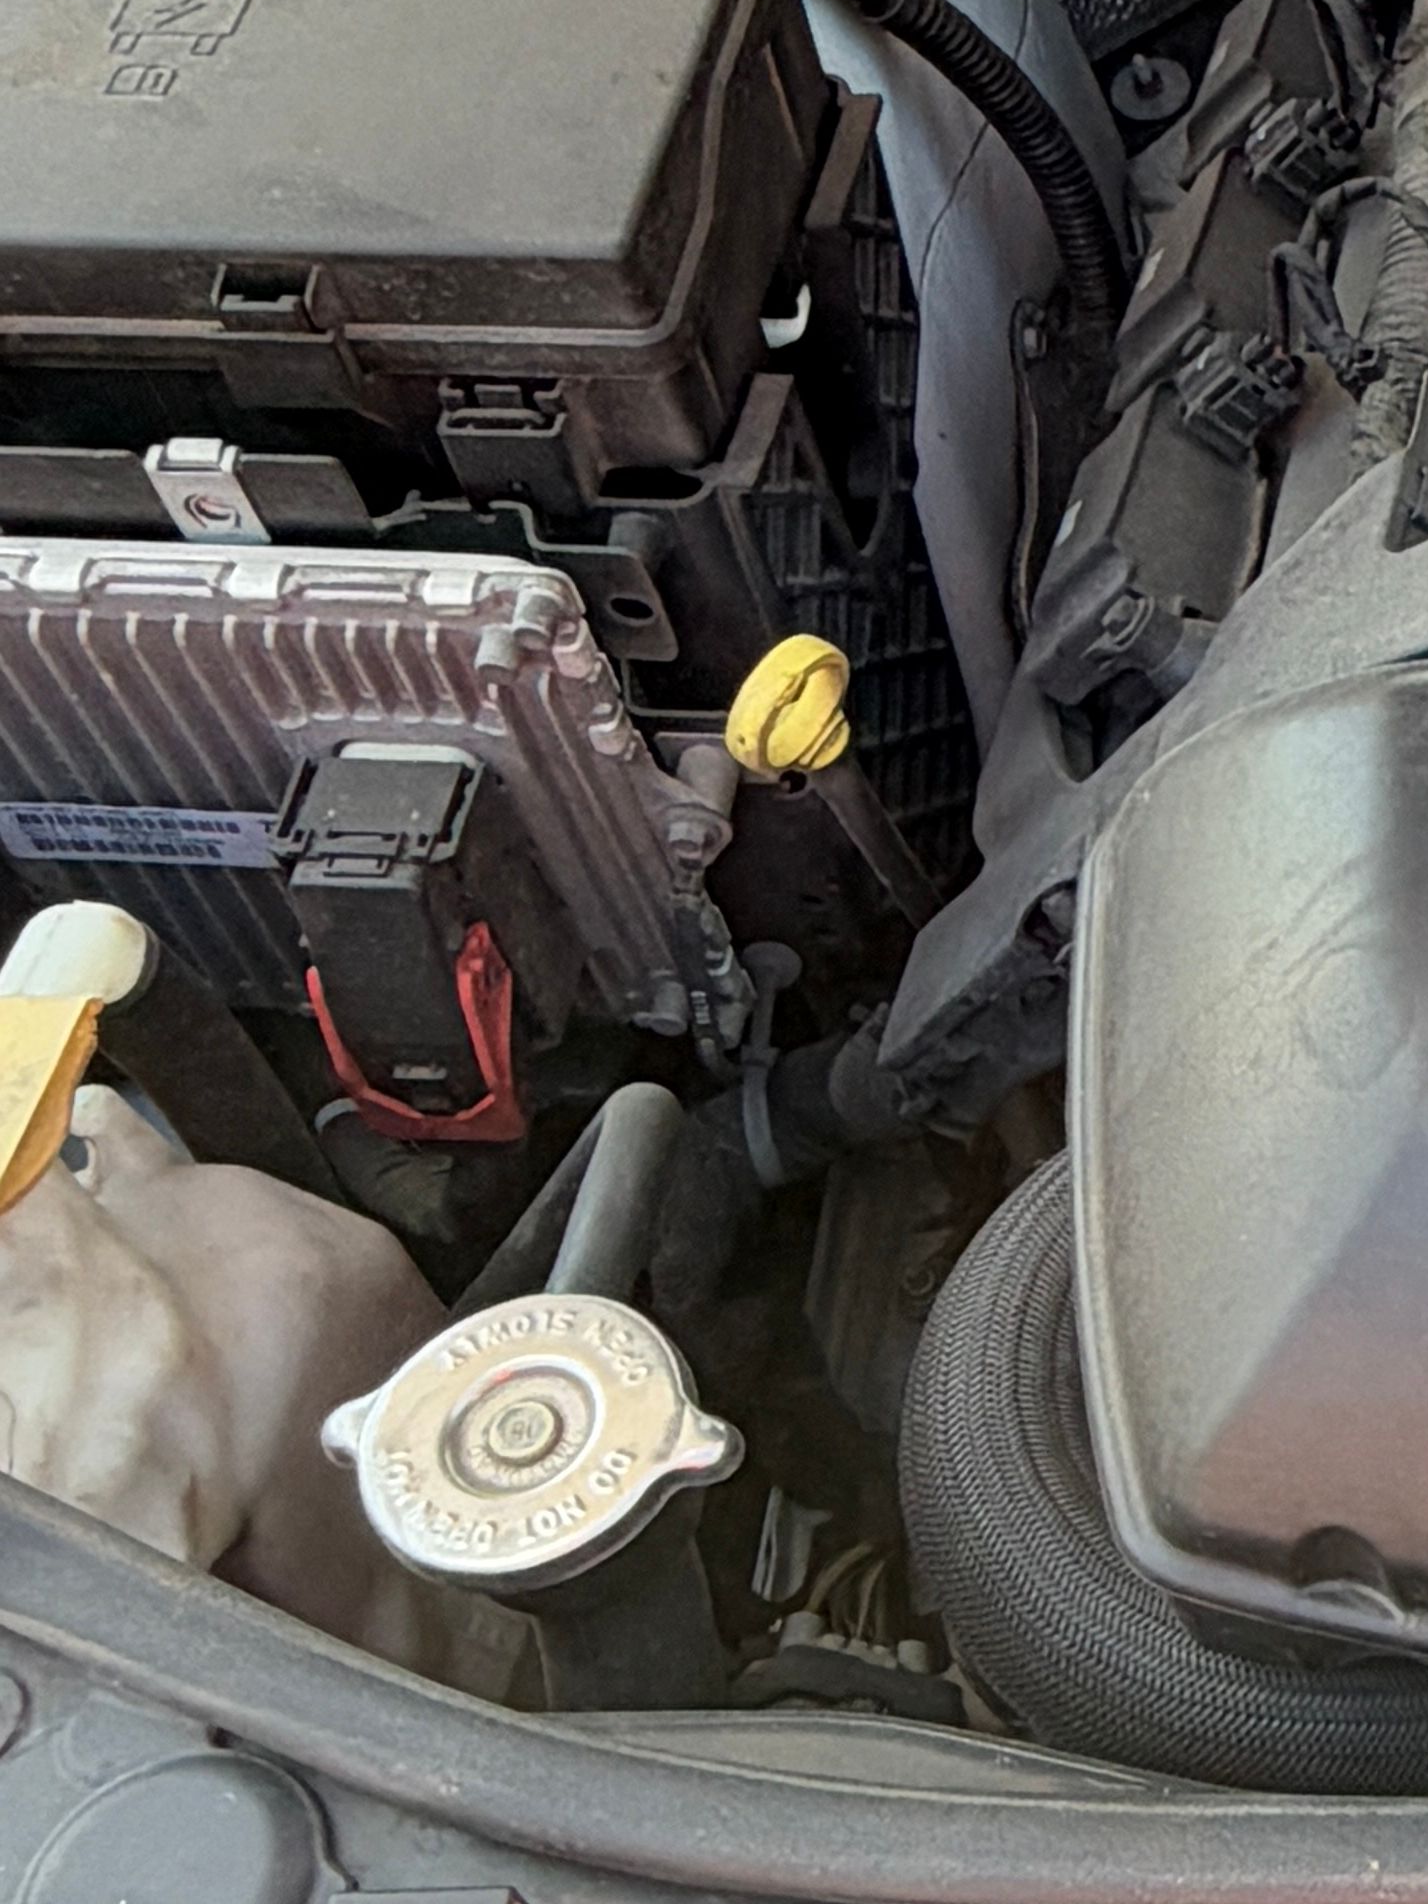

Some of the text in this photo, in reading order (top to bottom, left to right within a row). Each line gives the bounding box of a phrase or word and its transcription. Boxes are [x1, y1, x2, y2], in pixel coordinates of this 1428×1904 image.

[441, 1309, 651, 1387] OPEN SLOWLY
[588, 1448, 638, 1496] DO
[517, 1493, 587, 1547] NOT
